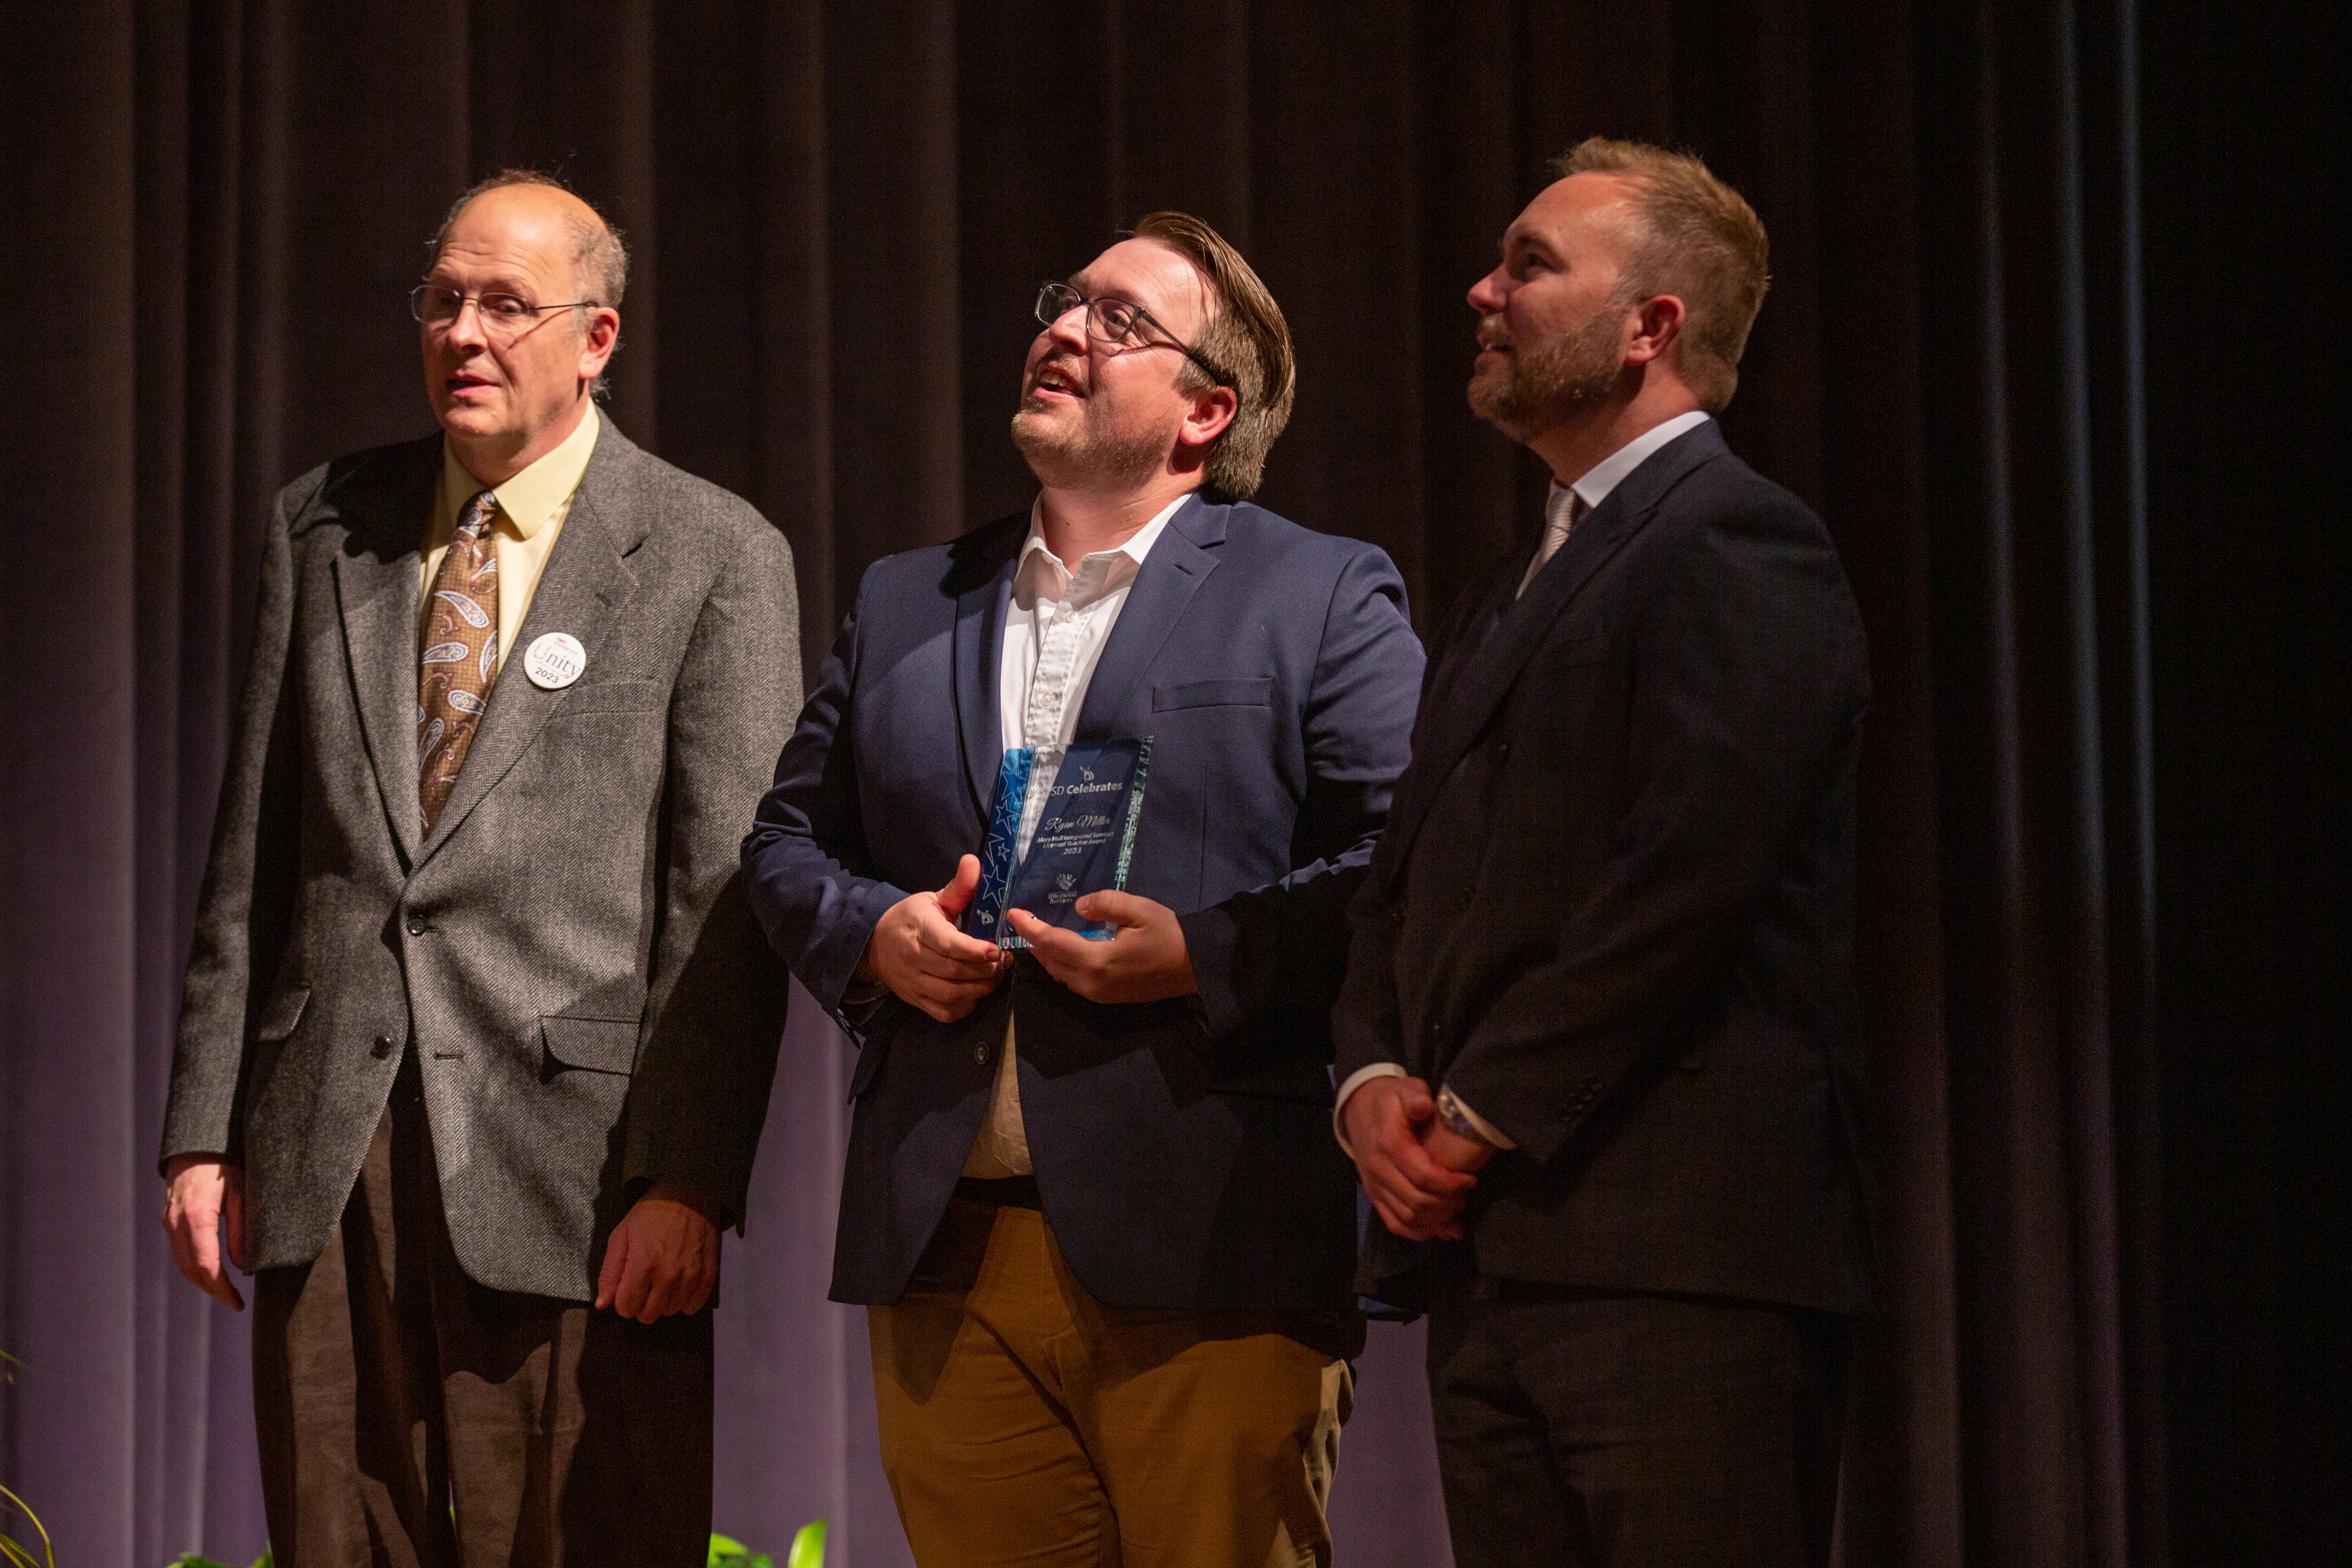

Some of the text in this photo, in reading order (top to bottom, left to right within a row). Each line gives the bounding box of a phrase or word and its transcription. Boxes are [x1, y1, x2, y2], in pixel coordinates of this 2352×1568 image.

[534, 642, 581, 678] Unity
[535, 667, 559, 683] 2023
[1067, 782, 1123, 795] Celebrates
[1045, 815, 1110, 833] Ryan Miller
